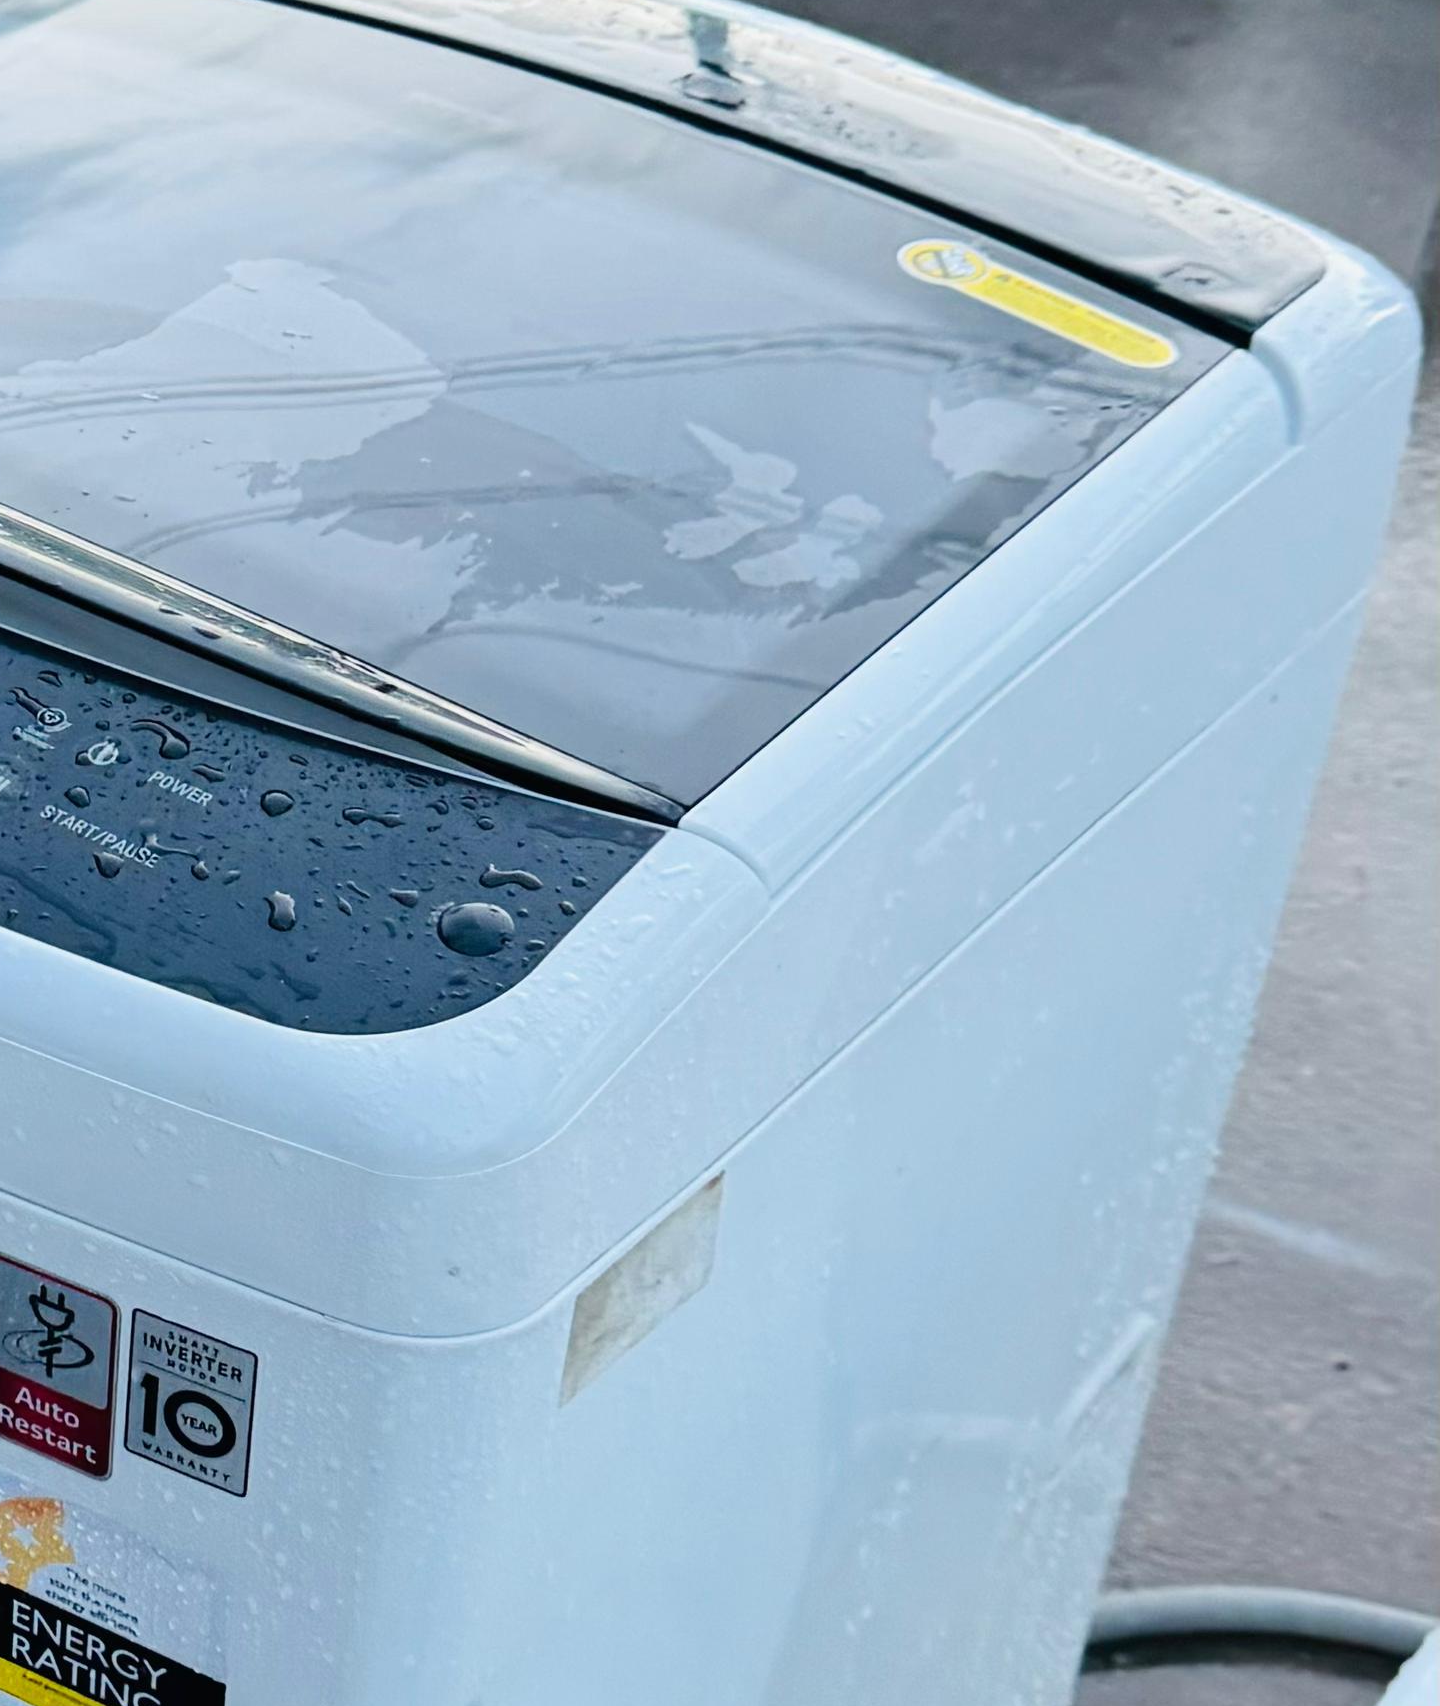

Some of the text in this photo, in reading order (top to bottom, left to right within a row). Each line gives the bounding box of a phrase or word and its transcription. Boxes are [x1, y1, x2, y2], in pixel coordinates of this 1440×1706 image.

[147, 771, 213, 806] POWER
[40, 804, 160, 868] START/PAUSE
[143, 1332, 242, 1383] INVERTER
[168, 1331, 220, 1358] SMART
[167, 1359, 217, 1384] MOTOR
[15, 1387, 80, 1428] Auto
[140, 1373, 237, 1458] 10
[181, 1413, 219, 1438] YEAR
[142, 1439, 231, 1482] WARRANTY
[12, 1598, 168, 1690] ENERGY
